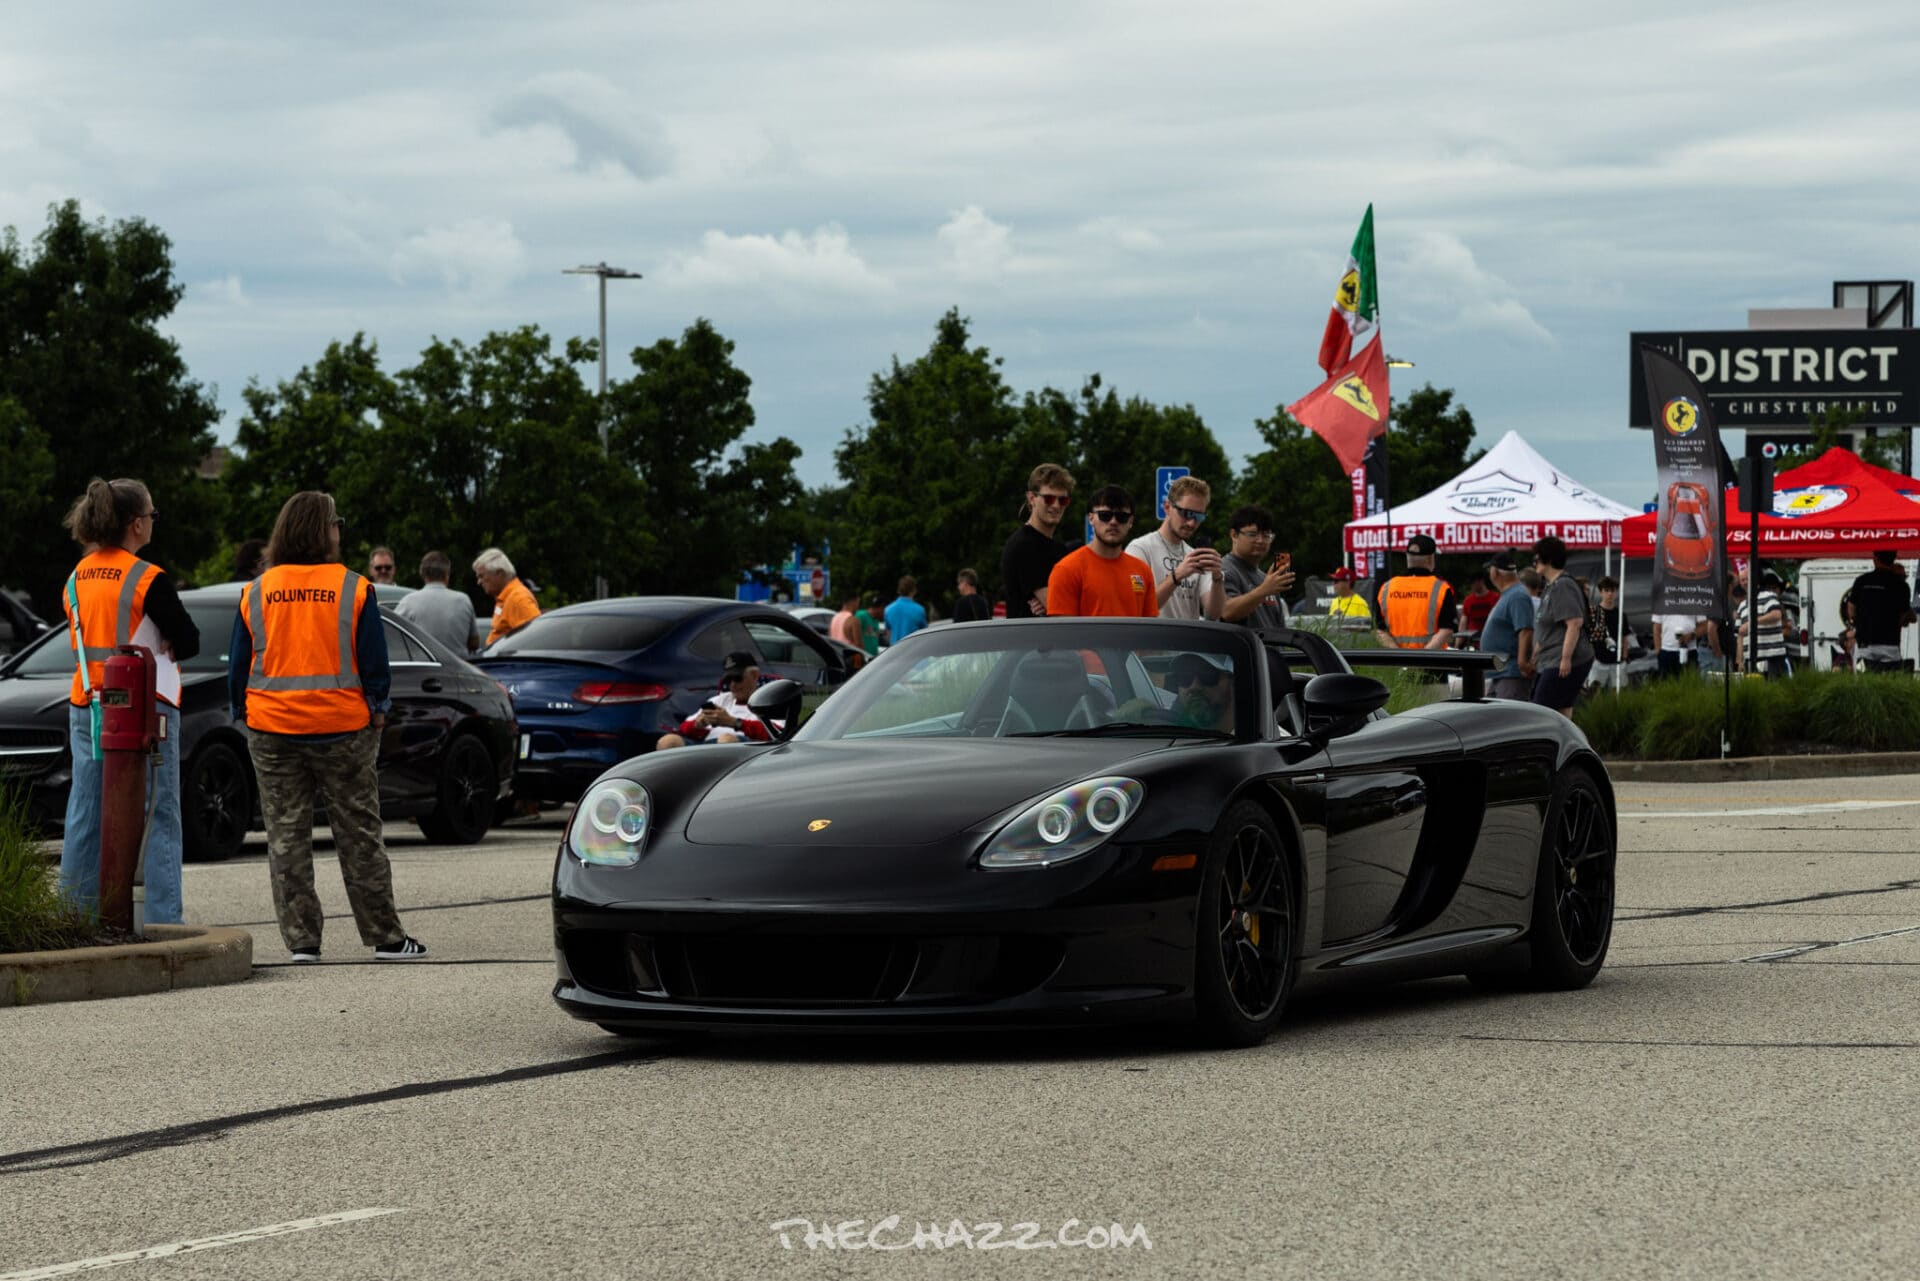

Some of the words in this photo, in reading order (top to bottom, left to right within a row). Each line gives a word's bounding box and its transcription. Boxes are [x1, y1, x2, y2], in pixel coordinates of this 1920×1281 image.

[1687, 346, 1899, 383] DISTRICT
[1764, 529, 1836, 542] ILLINOIS
[1840, 528, 1919, 540] CHAPTER
[75, 567, 123, 582] LUNTEER
[265, 588, 336, 605] VOLUNTEER
[1389, 590, 1429, 600] VOLUNTEER
